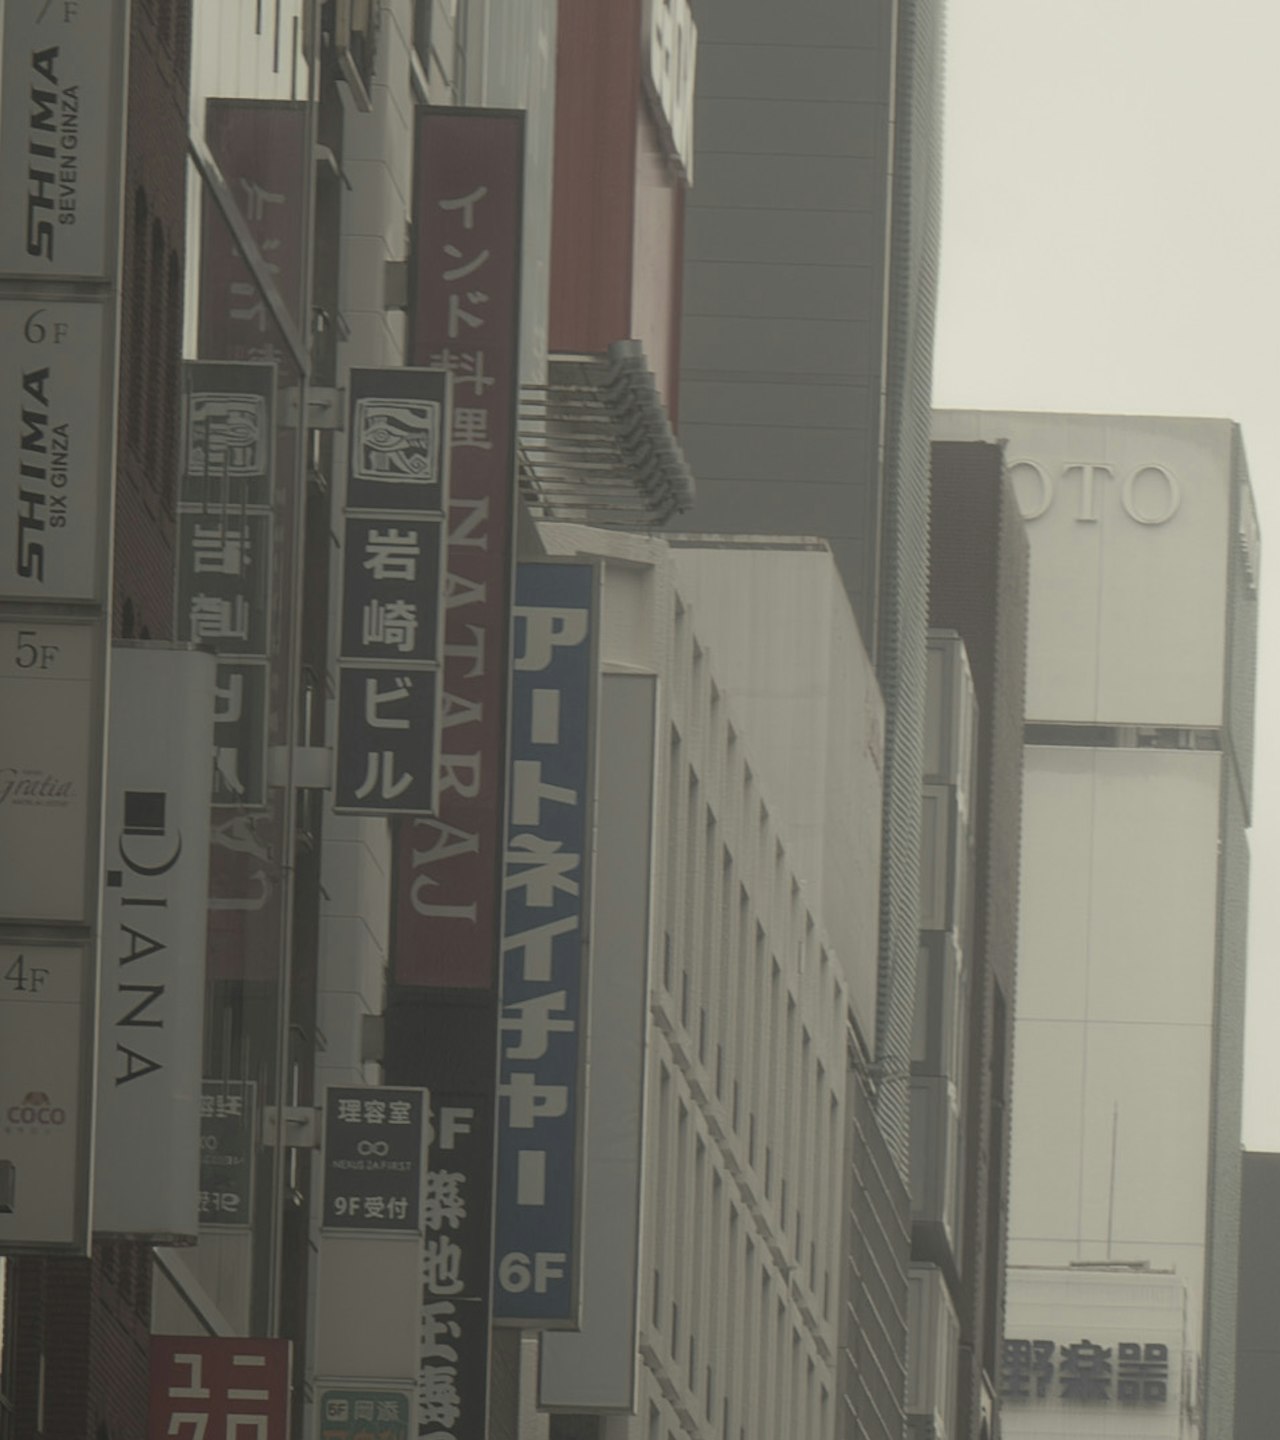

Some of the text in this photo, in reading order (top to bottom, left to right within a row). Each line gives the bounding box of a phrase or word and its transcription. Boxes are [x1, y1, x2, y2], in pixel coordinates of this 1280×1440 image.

[26, 45, 60, 262] SHIMA
[58, 85, 80, 225] SEVEN GINZA
[24, 308, 69, 344] 6F
[18, 366, 51, 583] SHIMA
[50, 422, 69, 528] SIX GINZA
[15, 631, 59, 670] 5F
[355, 528, 421, 799] 岩崎ビル
[411, 497, 490, 923] NATARAJ
[113, 791, 182, 1088] DIANA
[501, 605, 589, 1206] アートネイチャー
[4, 954, 50, 993] 4F
[337, 1100, 412, 1126] 理容室
[501, 1252, 566, 1292] 6F
[168, 1353, 269, 1400] ユニ
